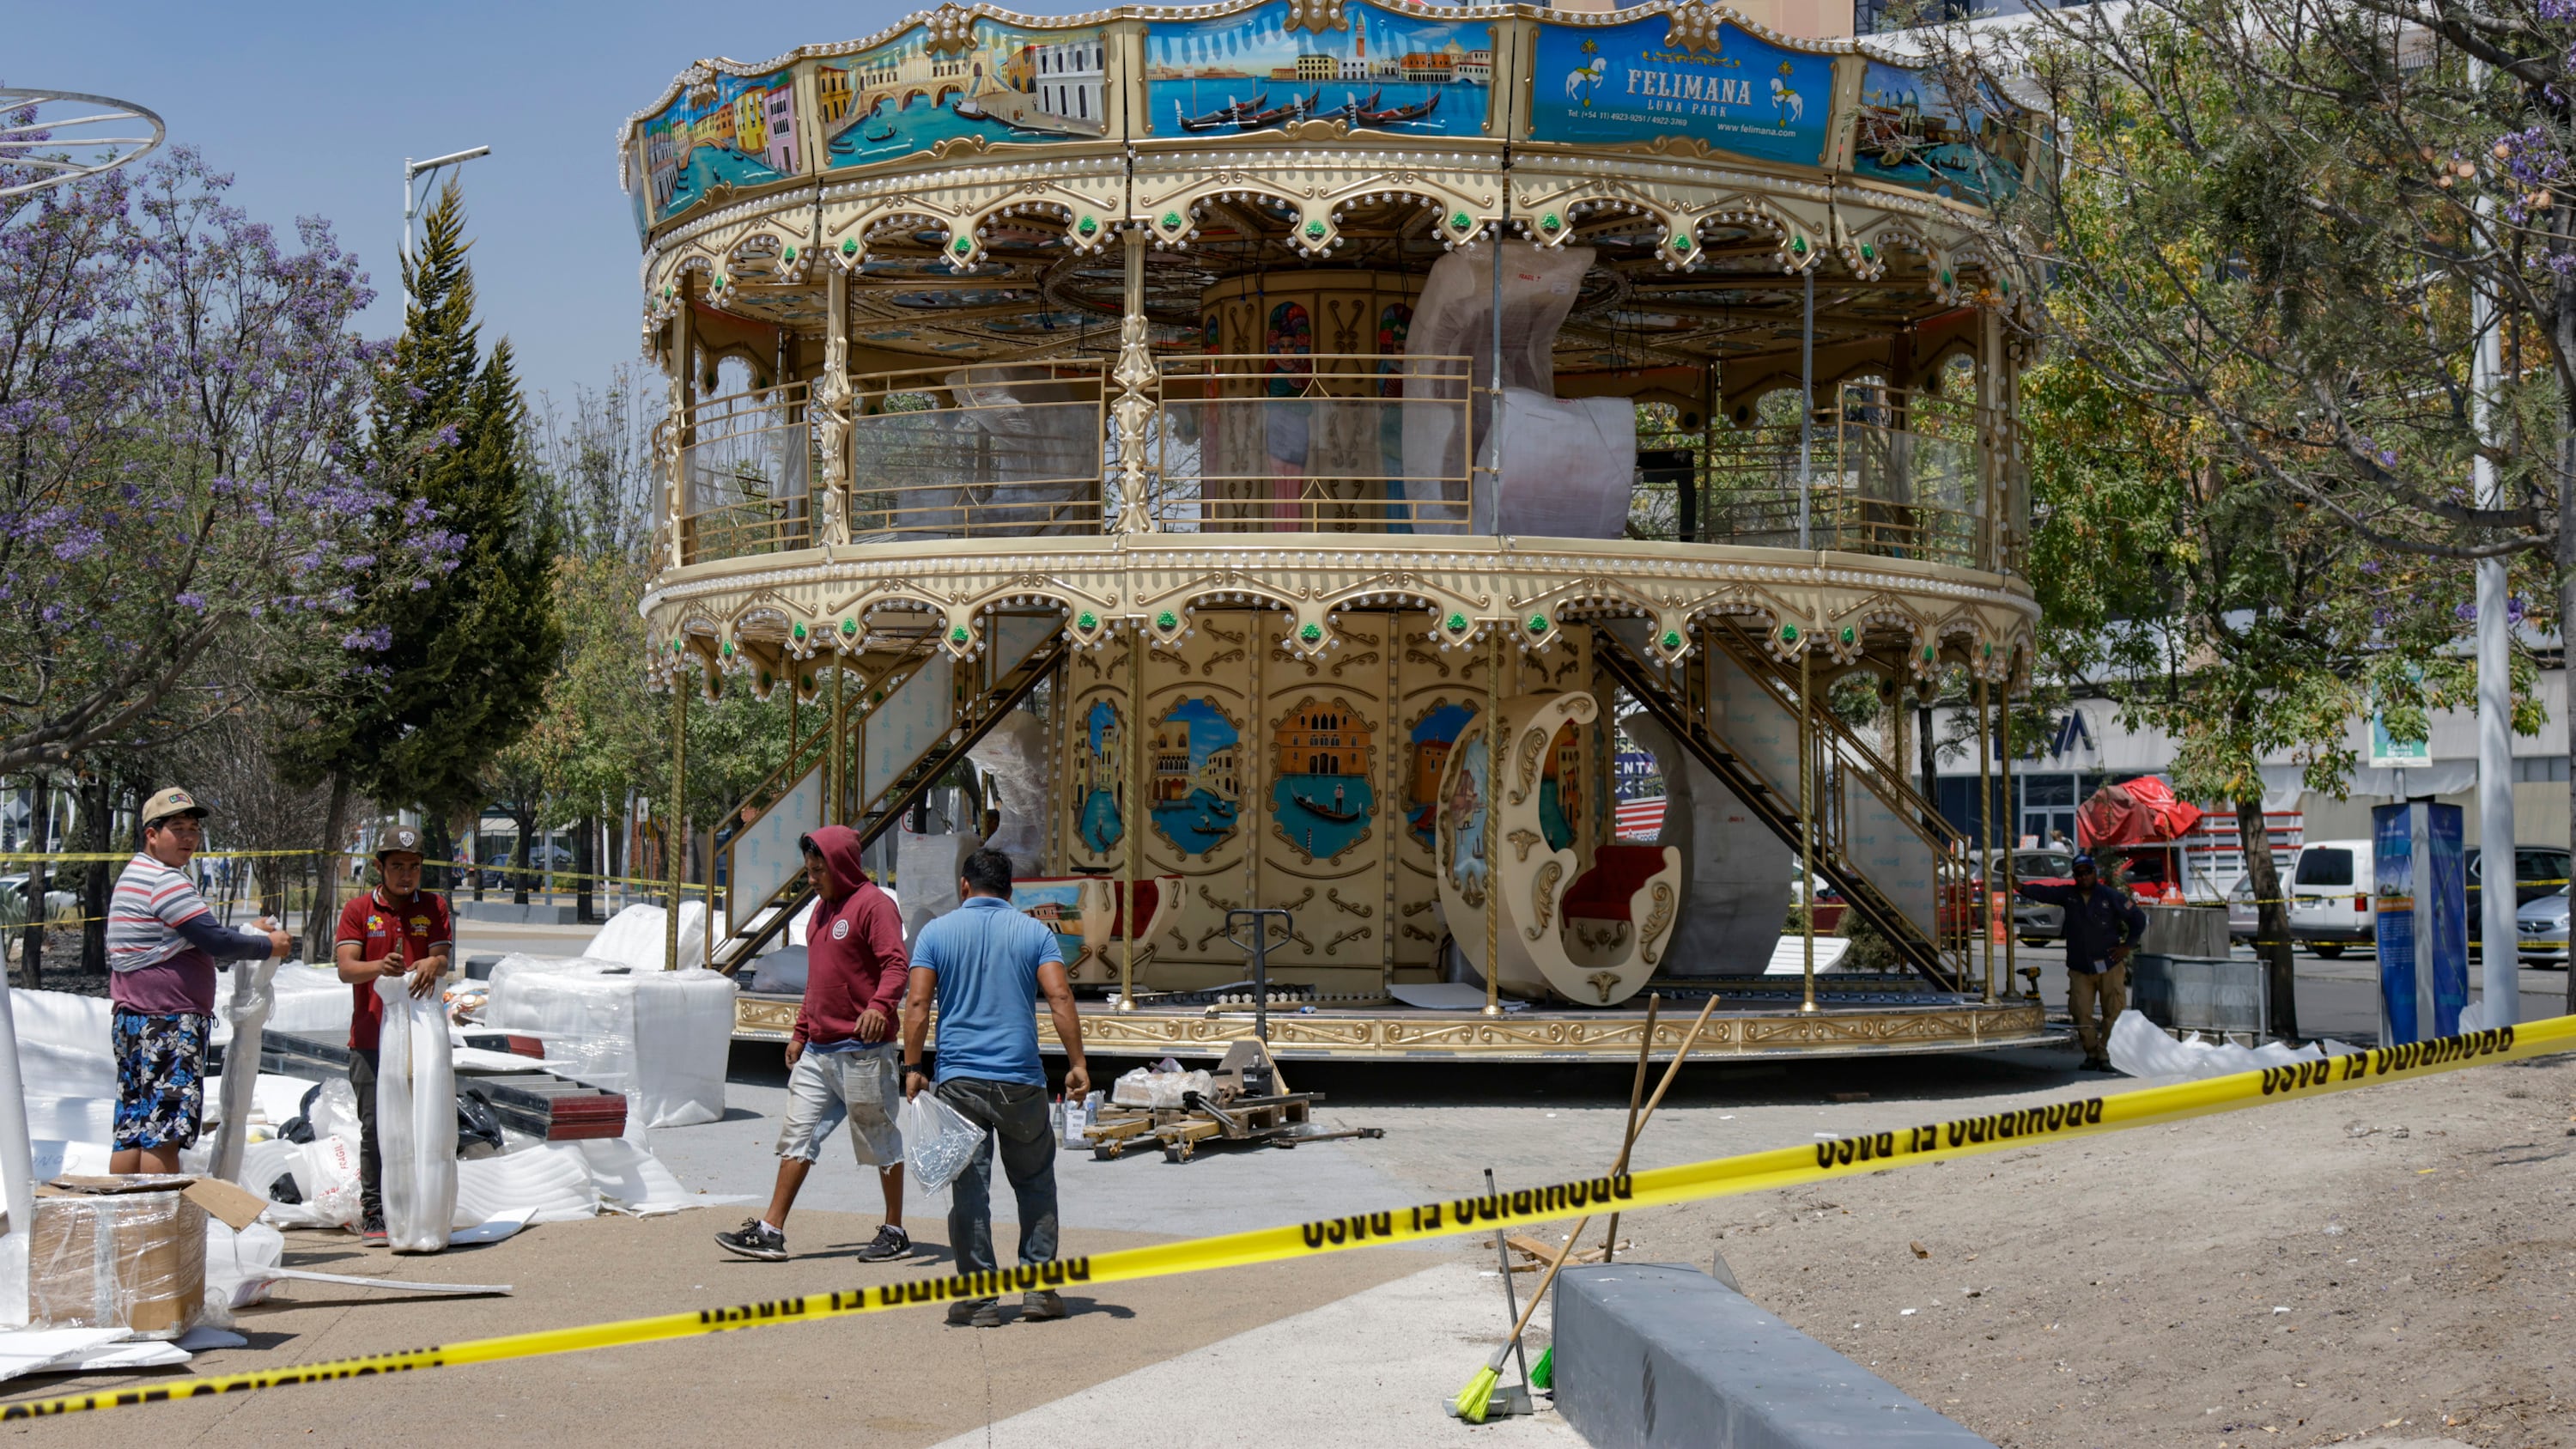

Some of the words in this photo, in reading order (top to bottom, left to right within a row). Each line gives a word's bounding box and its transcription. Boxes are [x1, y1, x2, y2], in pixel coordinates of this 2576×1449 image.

[1626, 69, 1752, 107] FELIMANA
[1647, 99, 1682, 113] LUNA
[1692, 104, 1727, 118] PARK
[334, 1143, 349, 1170] FRAGIL
